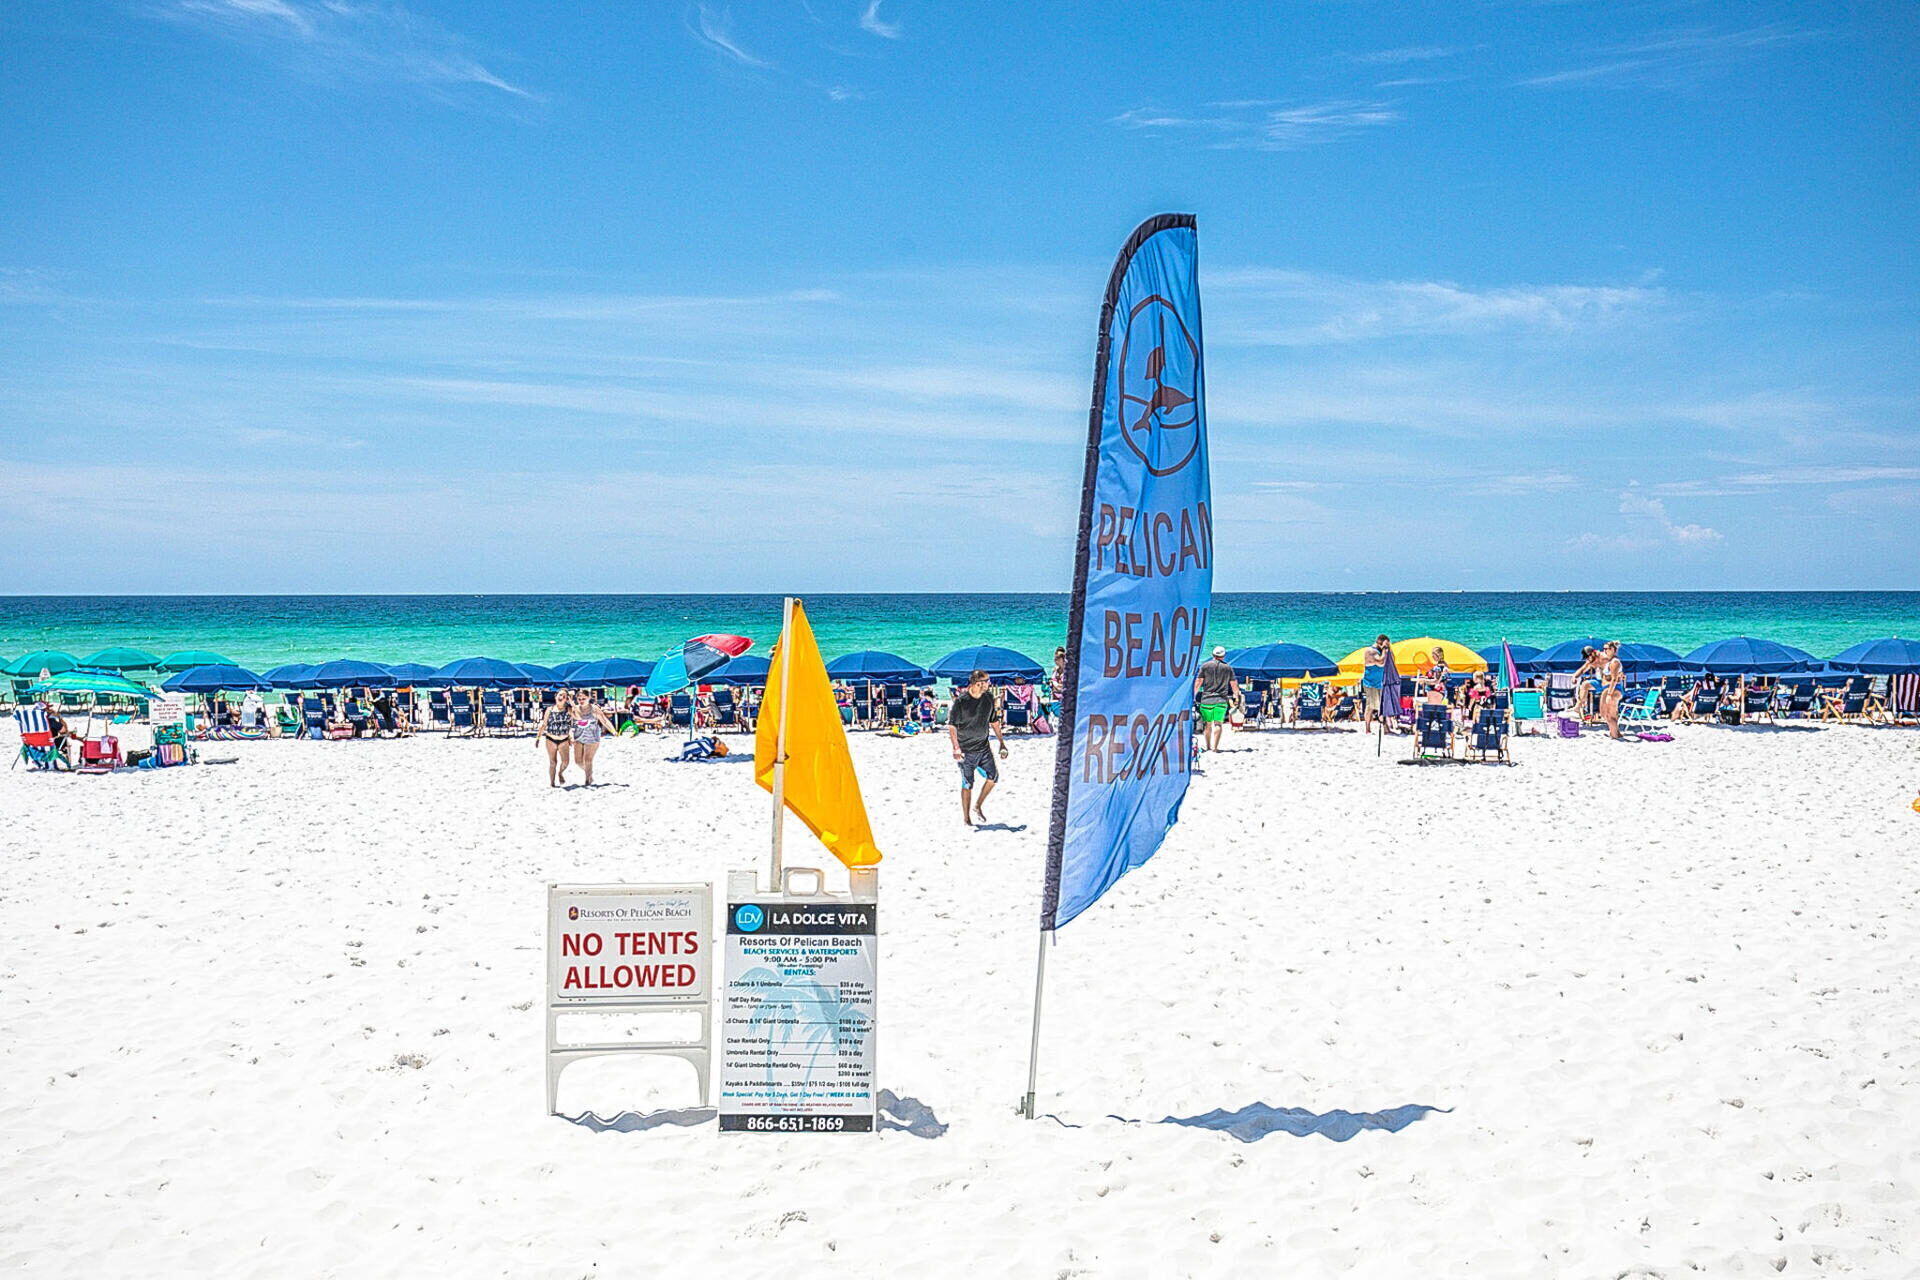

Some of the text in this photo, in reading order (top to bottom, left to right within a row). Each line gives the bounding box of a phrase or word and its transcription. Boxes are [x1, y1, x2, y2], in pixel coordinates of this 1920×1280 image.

[1097, 502, 1213, 577] PELICAN
[1103, 606, 1208, 678] BEACH
[1083, 709, 1190, 784] RESORT
[738, 912, 762, 924] LDV
[773, 913, 868, 924] LA DOLCE VITA
[562, 931, 699, 957] NO TENTS
[740, 936, 862, 947] Resorts Of Pelican Beach
[564, 964, 696, 989] ALLOWED
[747, 1117, 844, 1130] 866-651-1869
